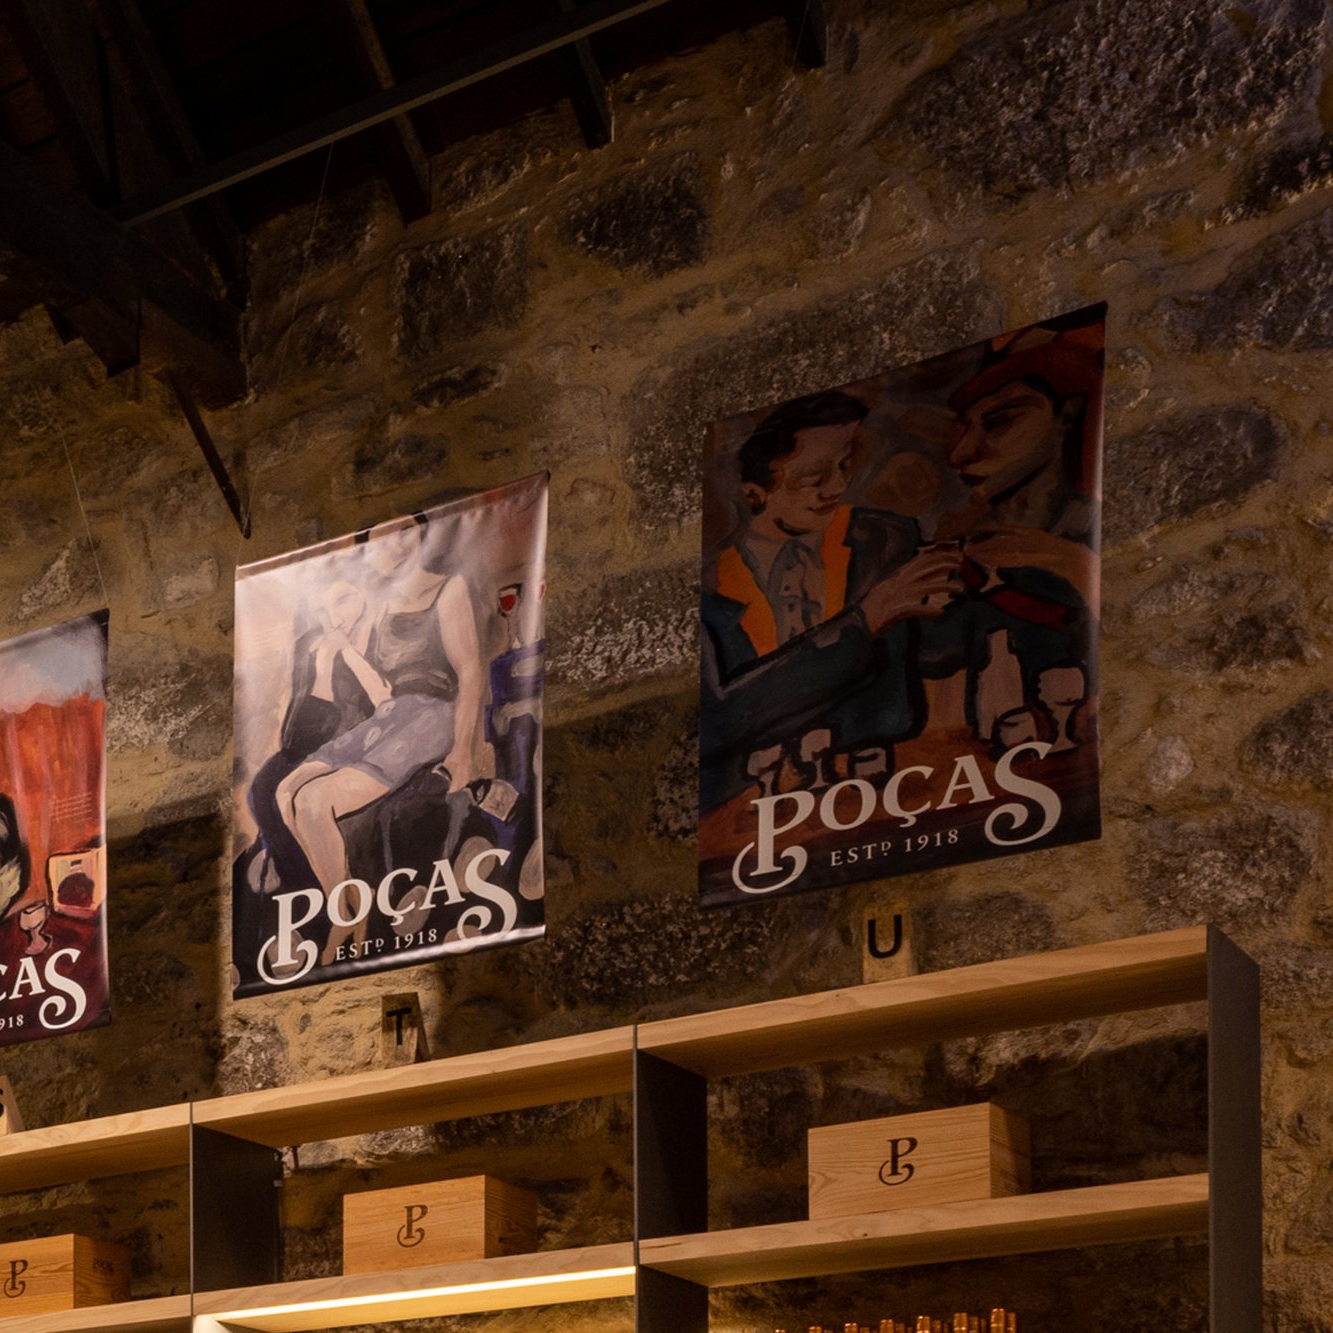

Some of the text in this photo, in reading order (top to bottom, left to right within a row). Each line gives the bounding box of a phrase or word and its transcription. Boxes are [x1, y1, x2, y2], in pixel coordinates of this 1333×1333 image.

[732, 741, 1062, 894] POÇAS
[904, 829, 960, 855] 1918
[257, 849, 518, 985] POÇAS
[868, 914, 902, 958] U
[393, 928, 438, 951] 1918
[386, 1007, 412, 1046] T
